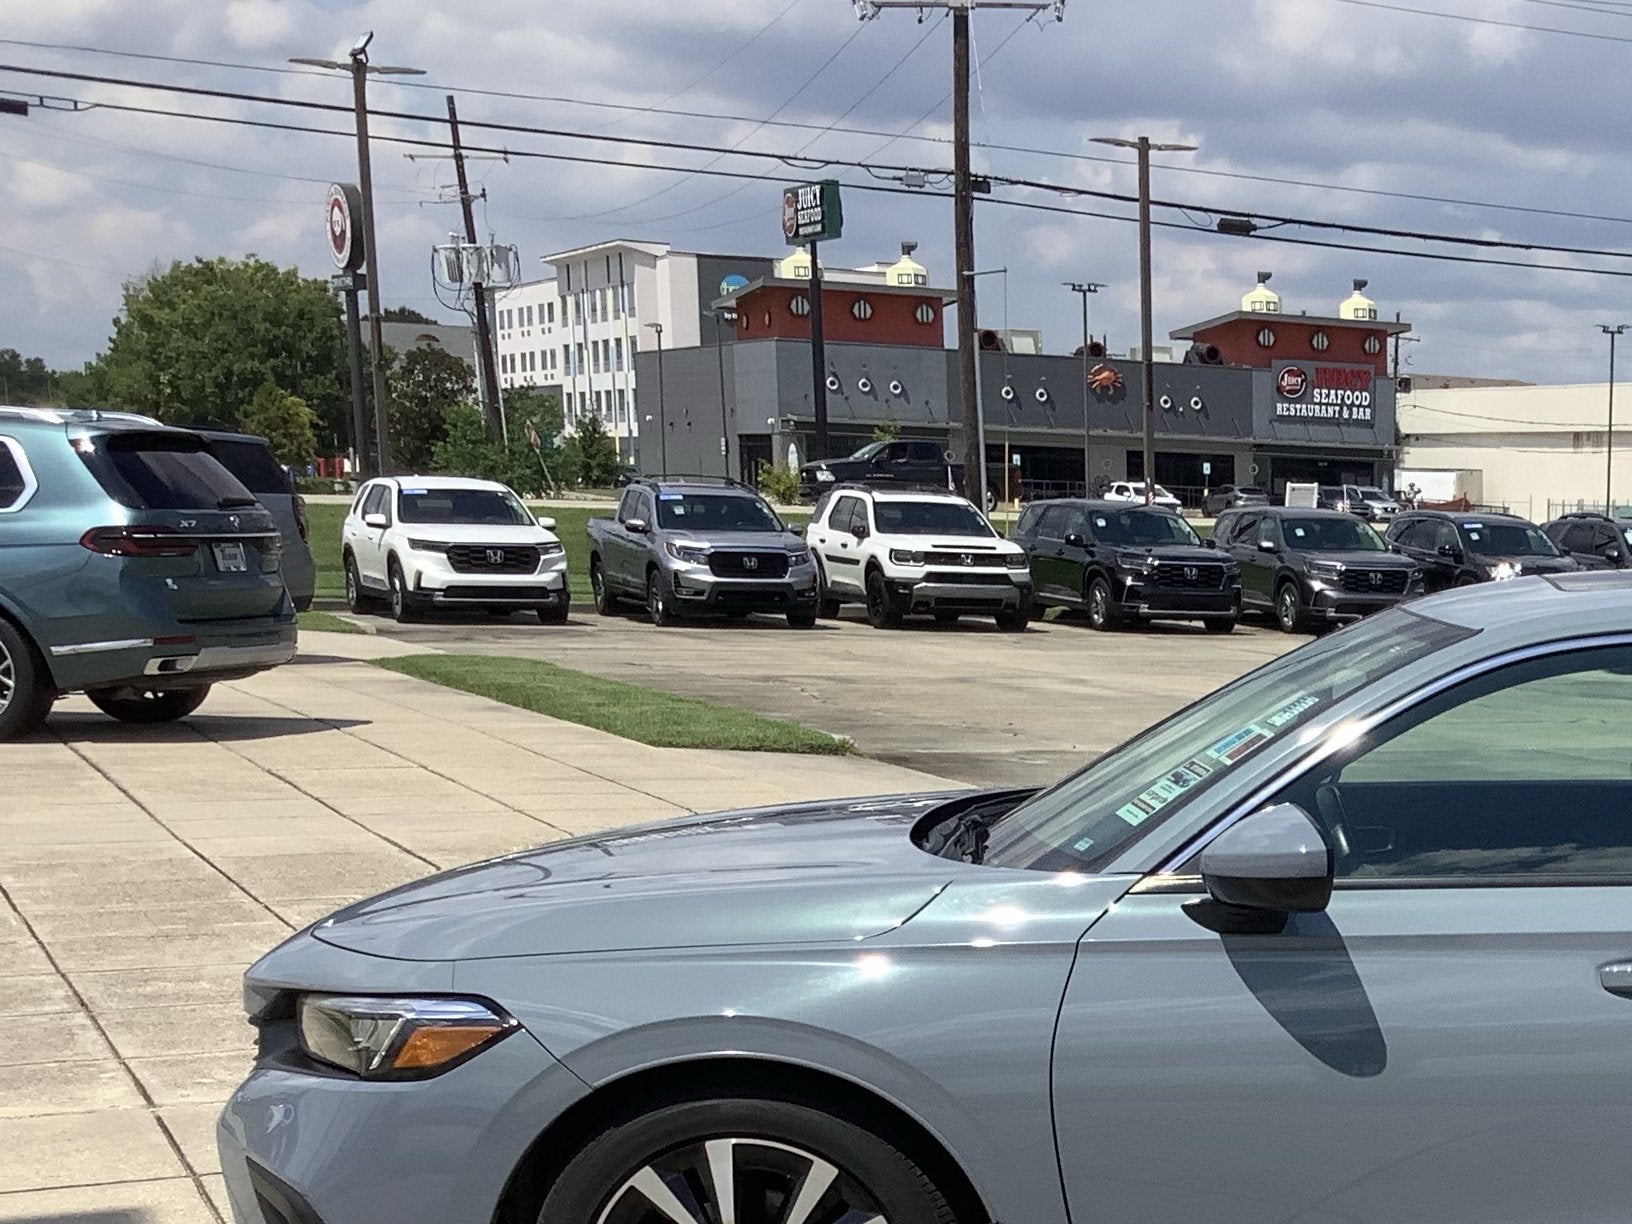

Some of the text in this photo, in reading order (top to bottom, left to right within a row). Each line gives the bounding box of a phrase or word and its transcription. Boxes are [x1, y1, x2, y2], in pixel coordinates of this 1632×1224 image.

[797, 185, 821, 210] JUICY
[1313, 388, 1370, 405] SEAFOOD
[1276, 403, 1371, 420] RESTAURANT & BAR
[180, 519, 197, 527] X7
